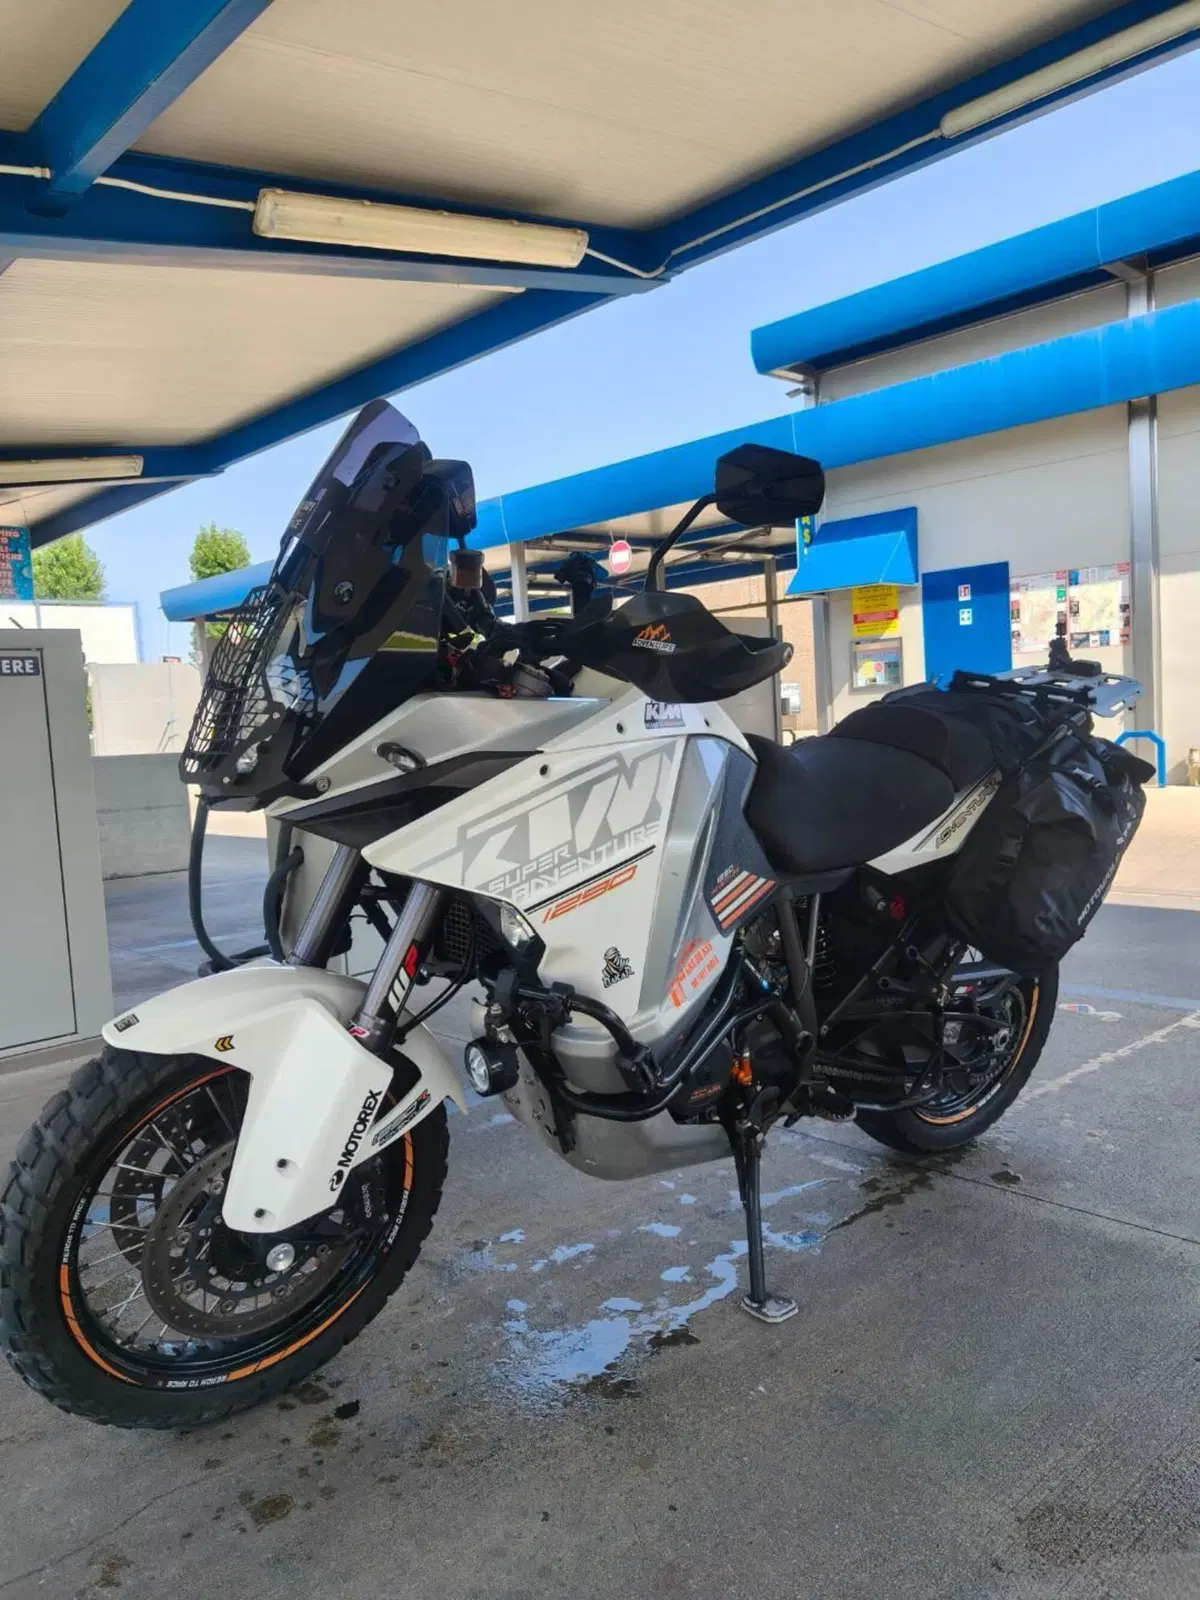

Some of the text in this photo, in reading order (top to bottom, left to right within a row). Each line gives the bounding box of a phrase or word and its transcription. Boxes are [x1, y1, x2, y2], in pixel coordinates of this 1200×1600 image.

[488, 843, 571, 893] SUPER
[511, 820, 661, 902] ADVENTURE
[543, 865, 638, 924] 1290
[338, 1089, 383, 1168] MOTOREX
